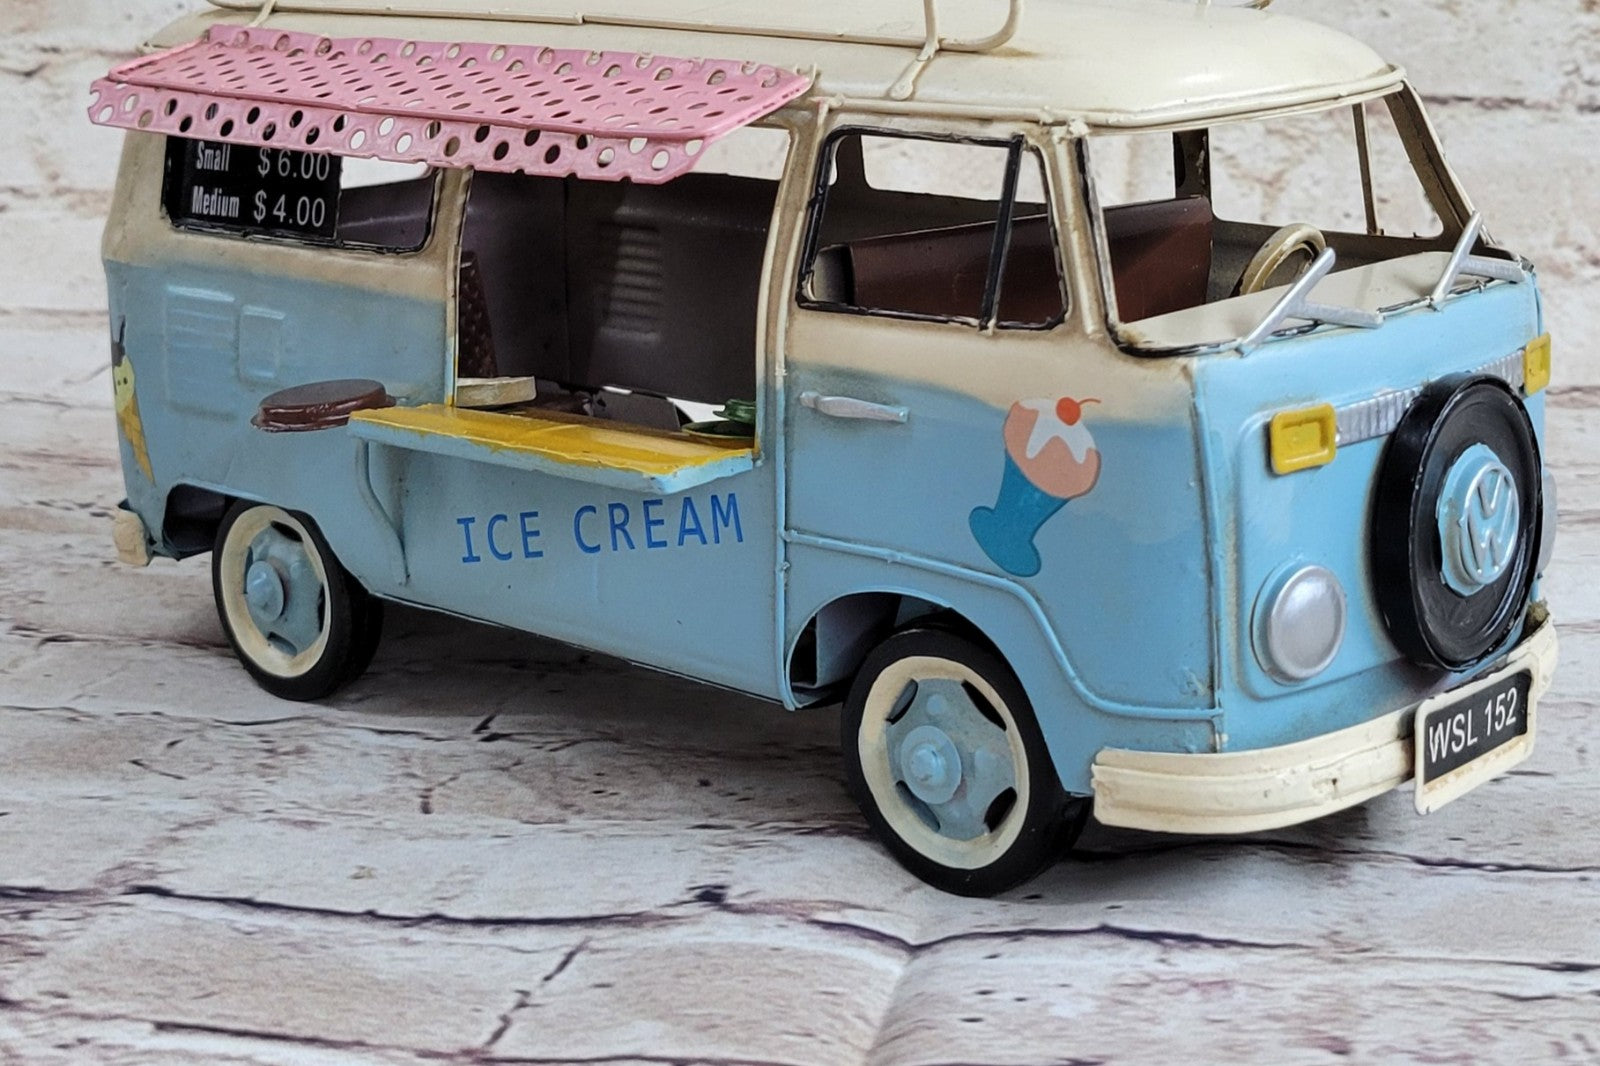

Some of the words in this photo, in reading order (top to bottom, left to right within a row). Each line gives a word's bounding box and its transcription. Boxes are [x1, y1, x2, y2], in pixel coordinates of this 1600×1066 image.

[196, 141, 231, 171] Small
[192, 185, 240, 218] Medium
[456, 511, 544, 563] ICE
[573, 493, 744, 553] CREAM
[1429, 709, 1477, 763] WSL
[1484, 686, 1517, 737] 152
